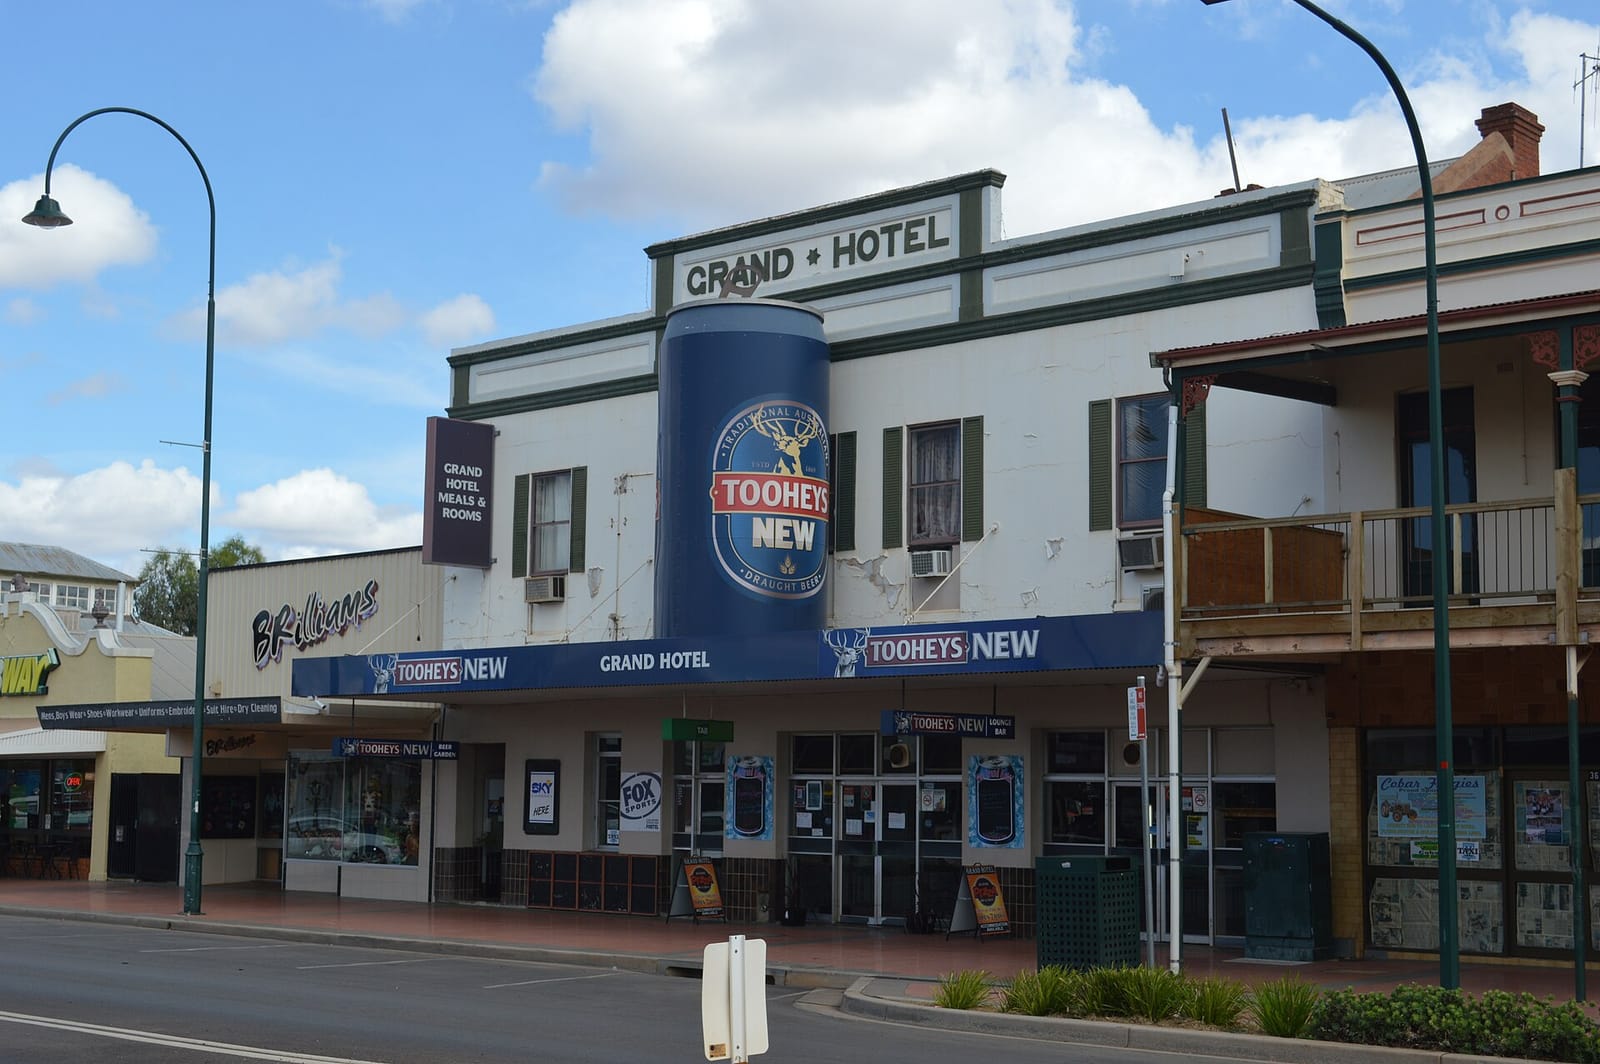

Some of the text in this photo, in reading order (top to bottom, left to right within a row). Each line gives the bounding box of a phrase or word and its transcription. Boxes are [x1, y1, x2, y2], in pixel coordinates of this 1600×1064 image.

[686, 215, 950, 296] GRAND HOTEL
[444, 463, 483, 477] GRAND
[446, 478, 480, 492] HOTEL
[438, 492, 486, 507] MEALS &
[721, 479, 829, 513] TOOHEYS
[442, 507, 482, 522] ROOMS
[752, 517, 816, 551] NEW
[744, 571, 820, 592] DRAUGHT BEER
[870, 629, 1041, 662] TOOHEYS NEW
[397, 656, 508, 682] TOOHEYS NEW
[600, 651, 711, 672] GRAND HOTEL
[87, 709, 103, 718] Shoes
[105, 708, 134, 718] Workwear
[139, 706, 165, 716] Uniforms
[168, 705, 196, 716] Embroide
[220, 704, 234, 714] Hire
[237, 703, 249, 714] Dry
[250, 702, 278, 714] Cleaning
[914, 716, 985, 733] TOOHEYS NEW
[989, 718, 1011, 727] LOUNGE
[994, 727, 1007, 736] BAR
[359, 743, 431, 756] TOOHEYS NEW
[531, 781, 553, 794] SKY
[1381, 777, 1479, 792] Cobar Fgies
[622, 778, 655, 808] FOX
[625, 798, 657, 814] SPORTS
